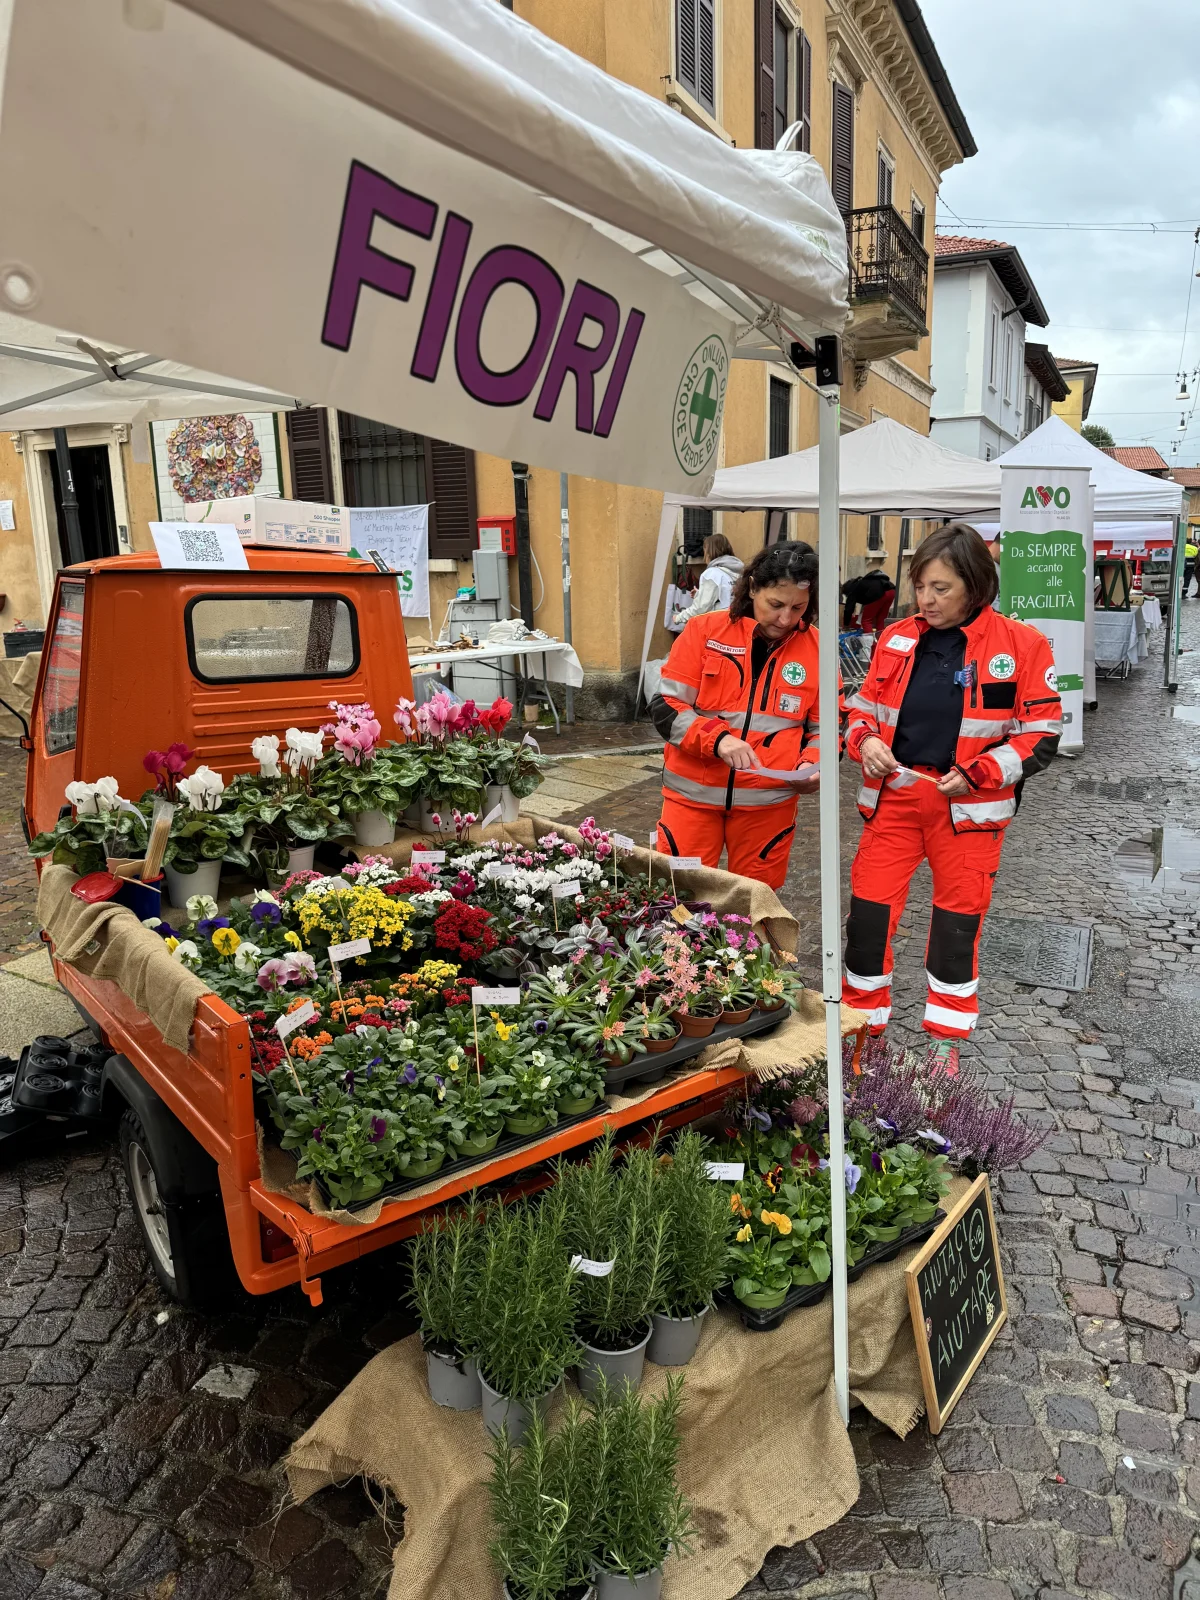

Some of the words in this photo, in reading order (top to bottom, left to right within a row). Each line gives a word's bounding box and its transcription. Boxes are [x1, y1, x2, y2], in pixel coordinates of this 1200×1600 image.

[321, 158, 645, 438] FIORI
[702, 344, 725, 372] ONLUS
[677, 362, 699, 438] CROCE
[705, 378, 727, 454] BAGGIO
[681, 437, 704, 468] VERDE
[1011, 547, 1024, 558] Da
[1027, 543, 1077, 557] SEMPRE
[1027, 563, 1063, 573] accanto
[1046, 576, 1063, 587] alle
[1011, 591, 1075, 609] FRAGILITÀ
[970, 1224, 983, 1251] CVB
[949, 1252, 968, 1297] ad
